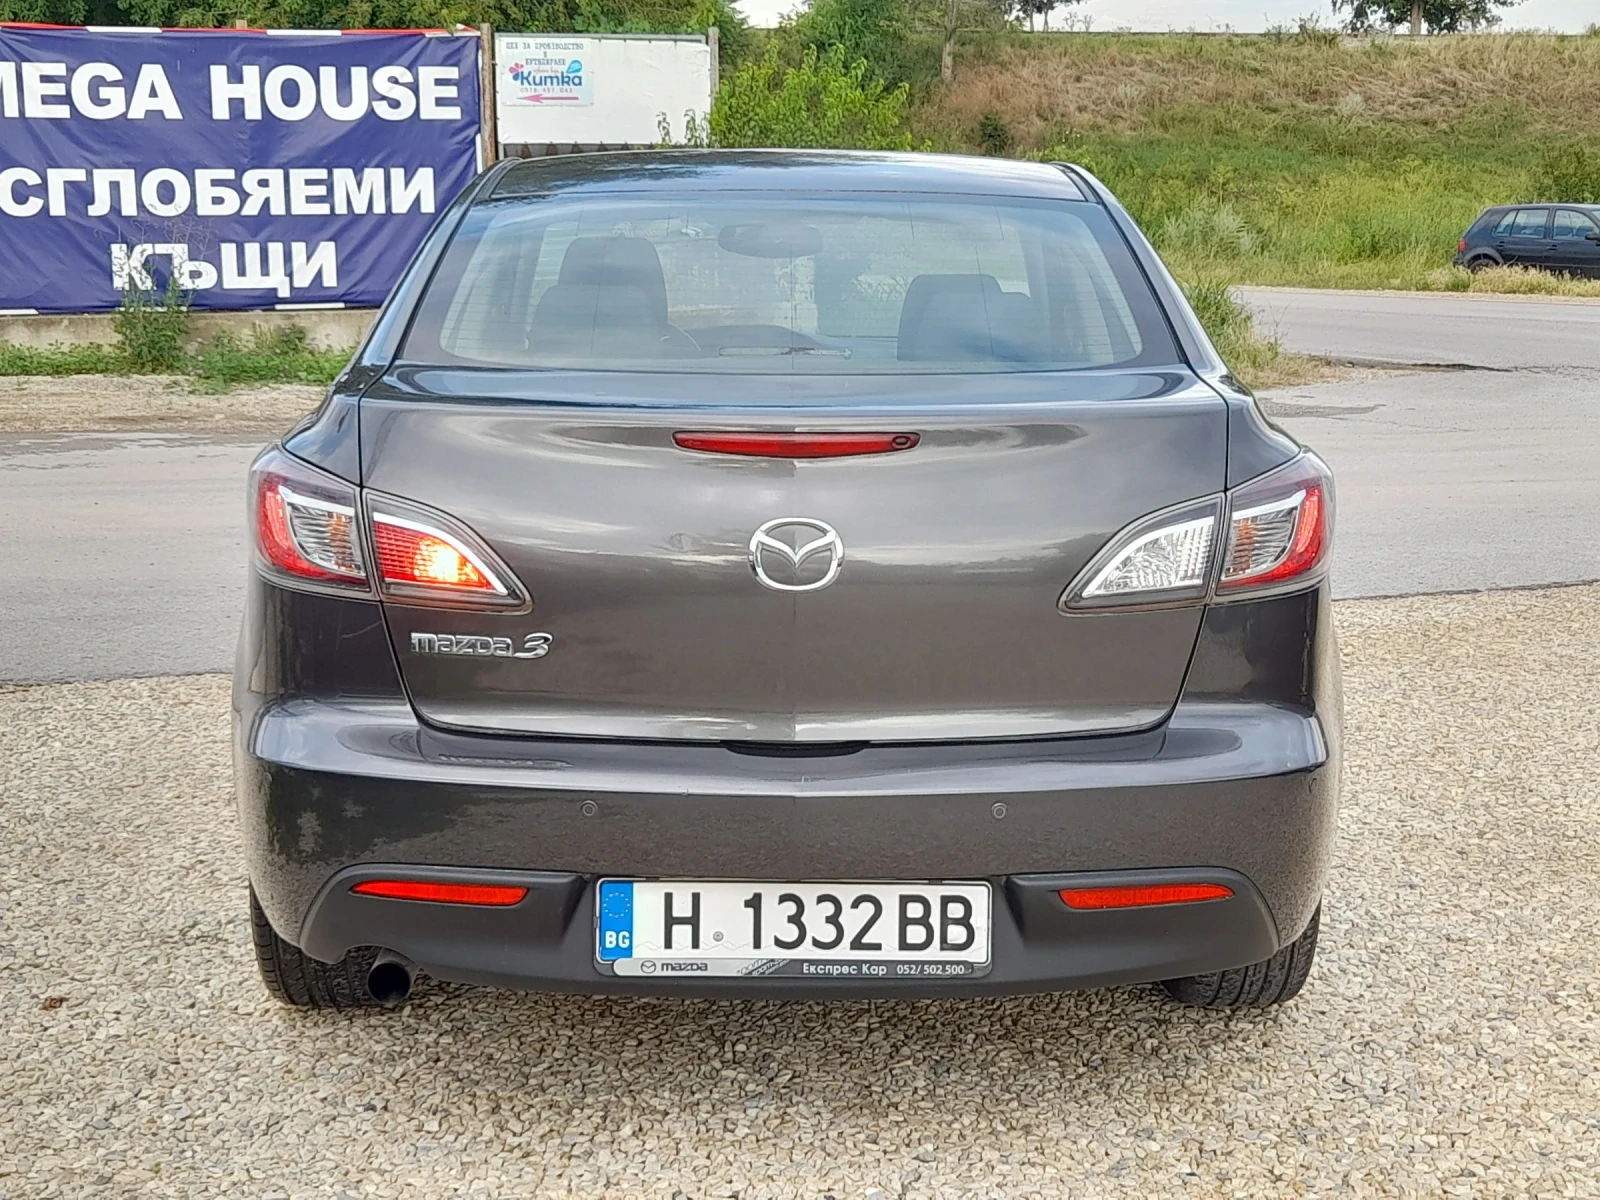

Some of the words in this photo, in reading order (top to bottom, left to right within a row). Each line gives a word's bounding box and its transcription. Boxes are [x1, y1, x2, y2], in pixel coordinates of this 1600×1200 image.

[209, 64, 462, 121] HOUSE
[0, 167, 435, 217] СГЛОБЯЕМИ
[110, 241, 338, 298] КЪЩИ
[605, 930, 630, 949] BG
[803, 962, 860, 976] Експрес
[861, 963, 887, 976] Кар
